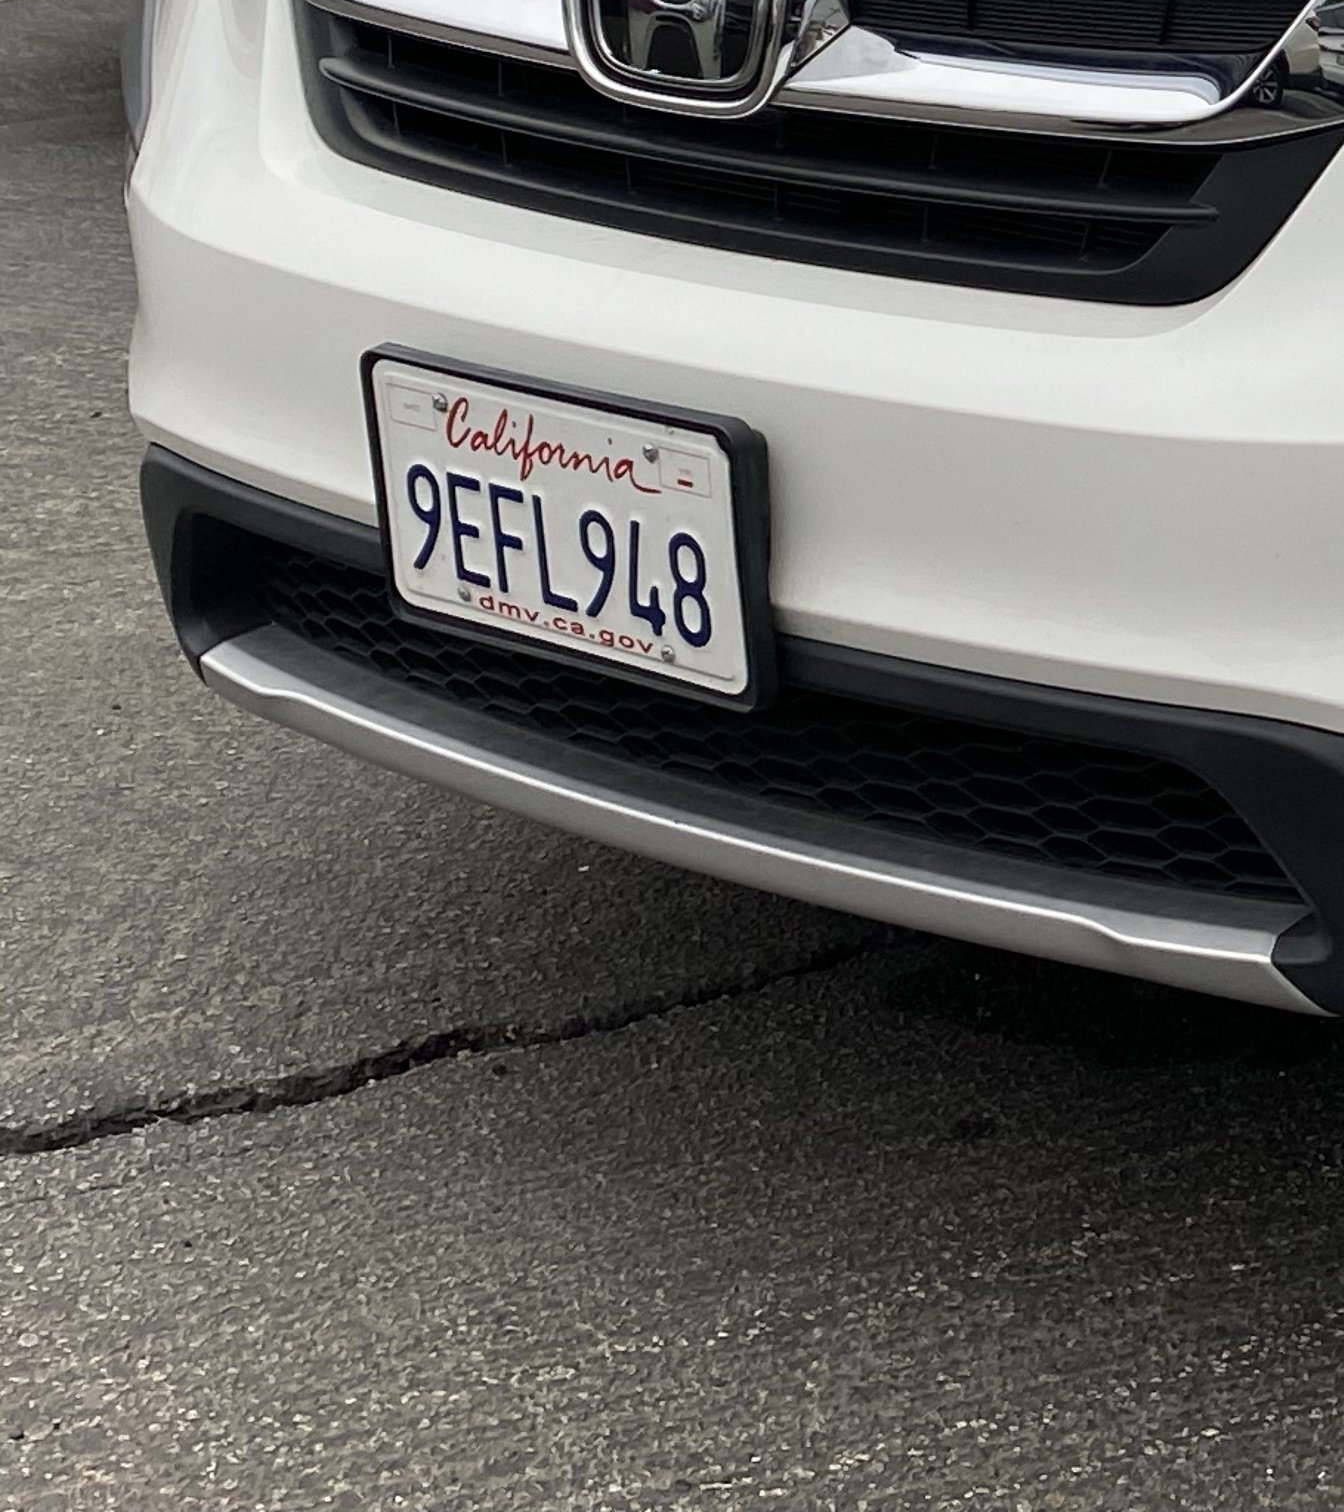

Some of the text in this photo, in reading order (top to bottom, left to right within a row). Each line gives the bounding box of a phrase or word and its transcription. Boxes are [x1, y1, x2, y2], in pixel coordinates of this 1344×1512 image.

[444, 397, 662, 495] California
[406, 463, 712, 648] 9EFL948
[478, 593, 654, 655] dmv.ca.gov
